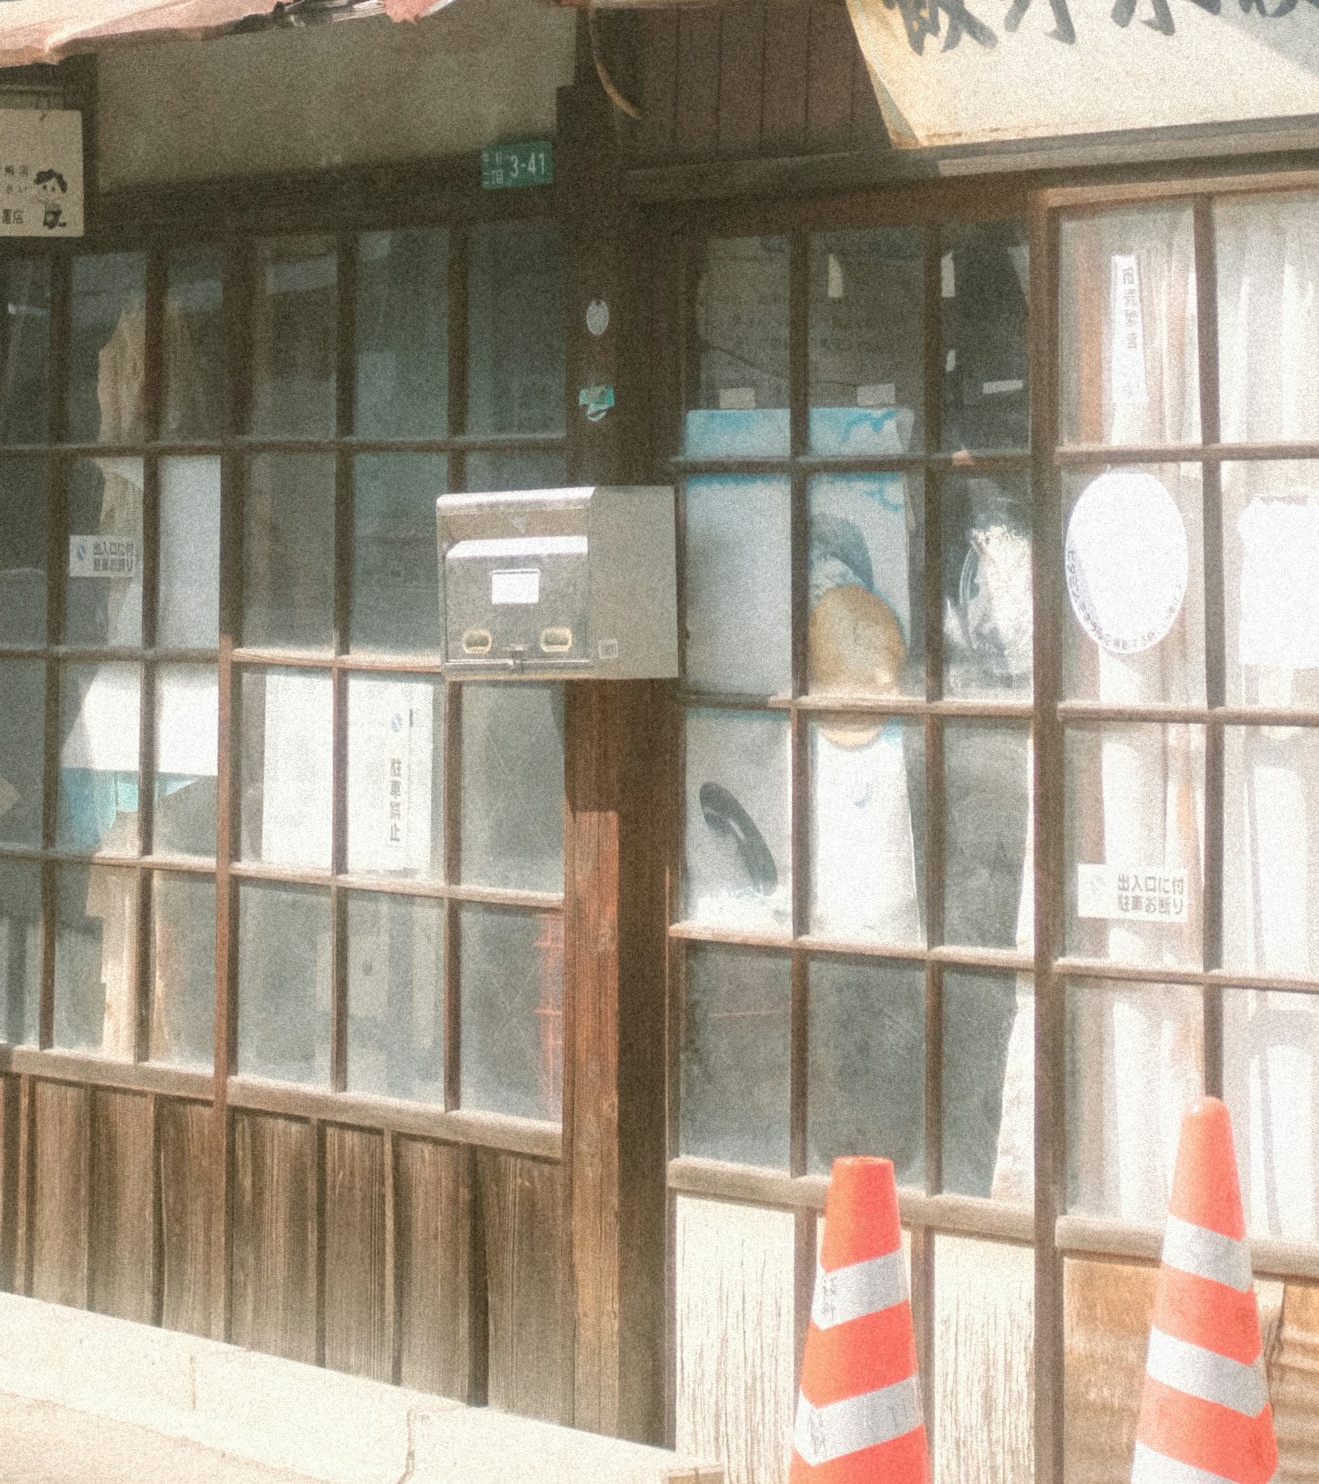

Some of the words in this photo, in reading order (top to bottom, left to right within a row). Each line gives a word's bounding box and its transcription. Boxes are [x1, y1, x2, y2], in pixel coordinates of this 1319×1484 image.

[510, 152, 545, 178] 3-41
[1117, 872, 1184, 895] 出入口に付
[1117, 893, 1184, 915] 駐車お断り
